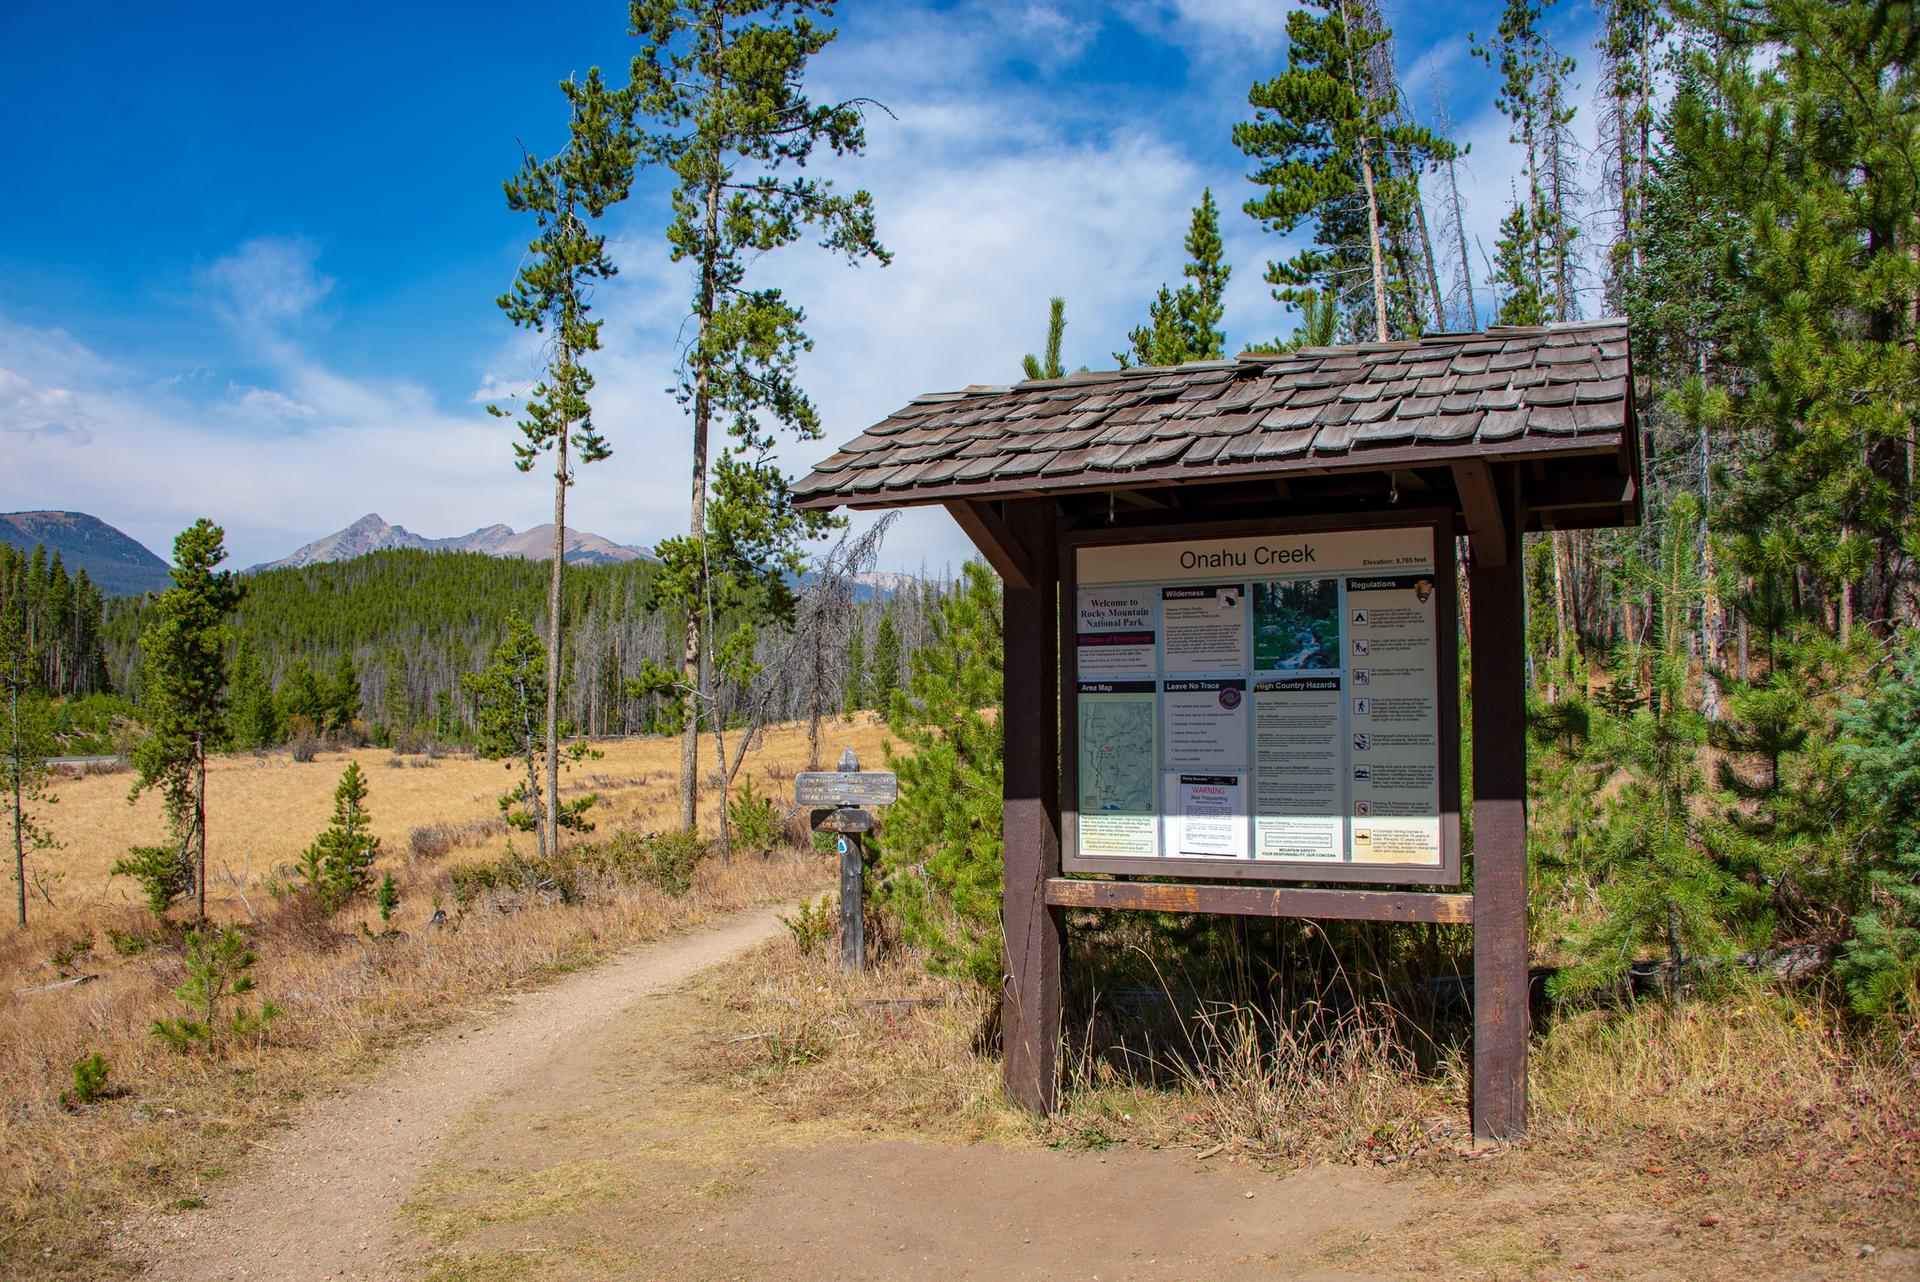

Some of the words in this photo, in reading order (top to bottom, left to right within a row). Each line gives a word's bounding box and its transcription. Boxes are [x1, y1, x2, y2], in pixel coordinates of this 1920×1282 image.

[1180, 549, 1246, 569] Onahu
[1254, 544, 1316, 565] Creek
[1351, 581, 1397, 590] Regulations
[1166, 590, 1205, 598] Wilderness
[1090, 599, 1128, 608] Welcome
[1130, 599, 1138, 607] to
[1080, 609, 1106, 619] Rocky
[1108, 608, 1149, 617] Mountain
[1086, 619, 1121, 628] National
[1123, 618, 1144, 627] Park
[1098, 684, 1113, 692] Map
[1166, 682, 1188, 690] Leave
[1188, 682, 1199, 690] No
[1200, 682, 1220, 690] Trace
[1256, 682, 1274, 691] High
[1275, 681, 1305, 690] Country
[1306, 681, 1337, 689] Hazards
[1192, 787, 1225, 795] WARNING
